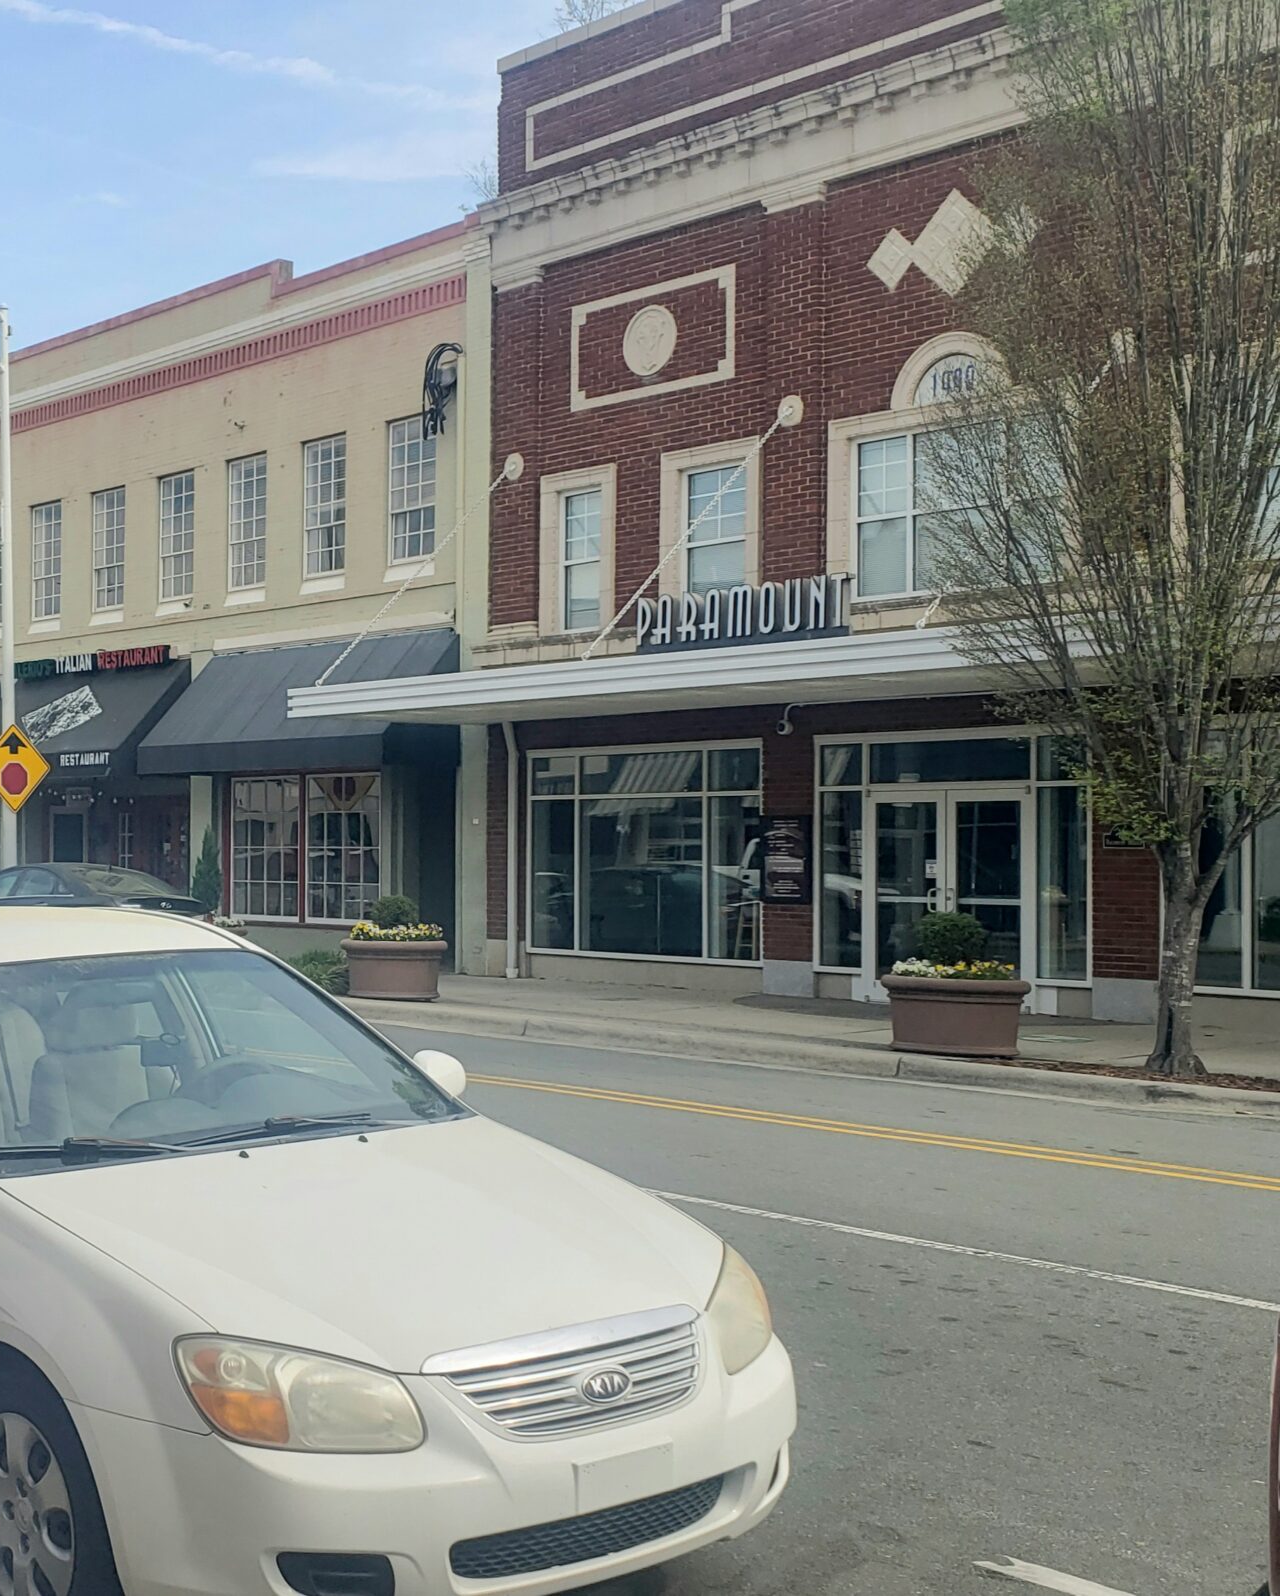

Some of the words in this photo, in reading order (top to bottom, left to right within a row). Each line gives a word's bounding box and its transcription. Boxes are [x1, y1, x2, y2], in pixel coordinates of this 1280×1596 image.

[636, 572, 854, 646] PARAMOUNT
[55, 652, 93, 674] ITALIAN
[97, 645, 164, 670] RESTAURANT
[60, 751, 110, 767] RESTAURANT
[589, 1373, 625, 1395] KIA
